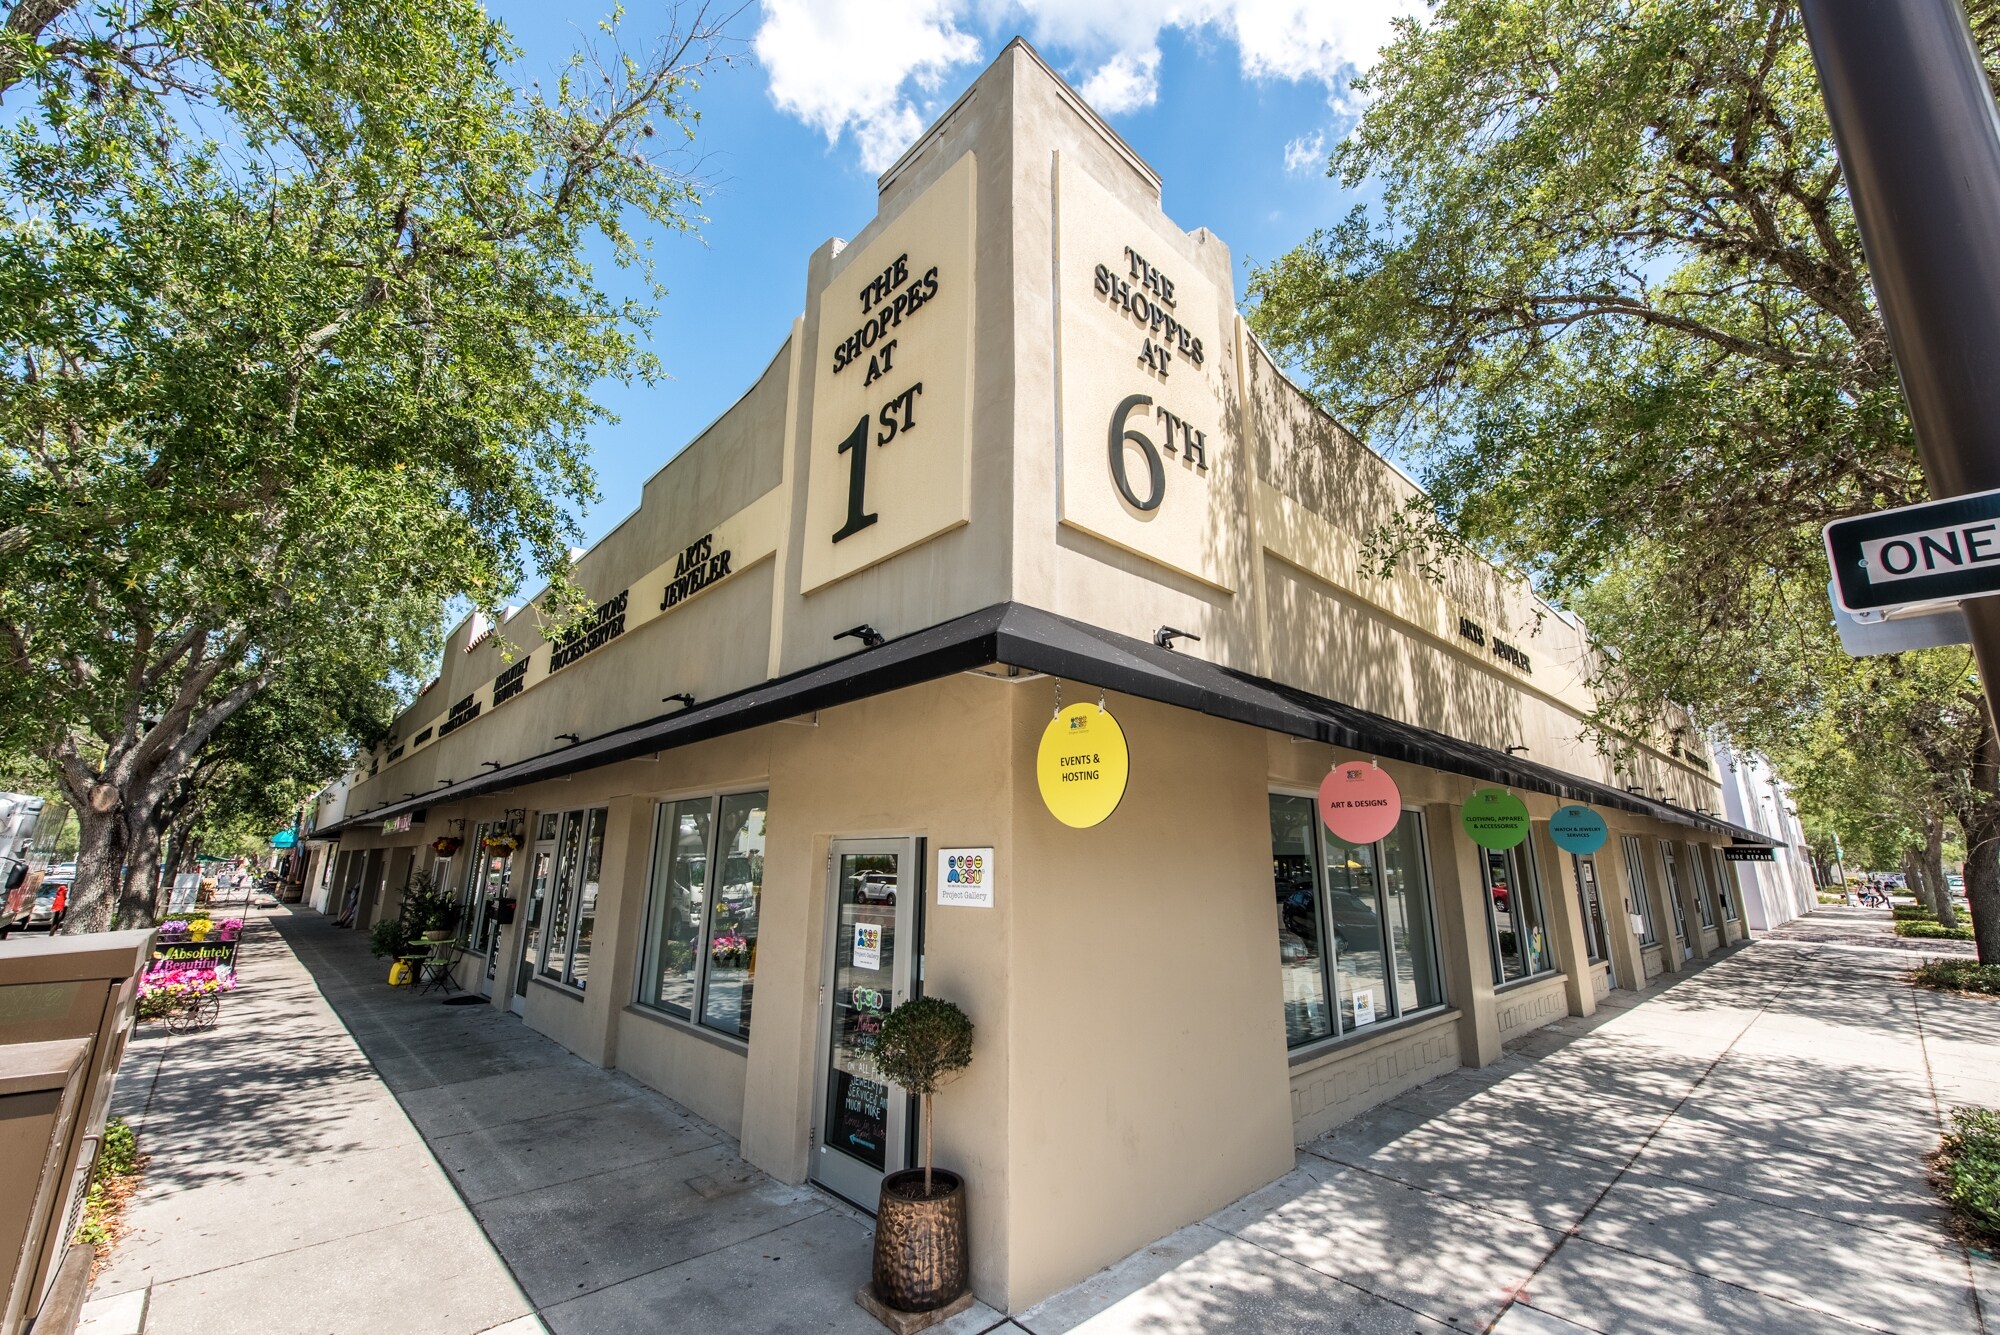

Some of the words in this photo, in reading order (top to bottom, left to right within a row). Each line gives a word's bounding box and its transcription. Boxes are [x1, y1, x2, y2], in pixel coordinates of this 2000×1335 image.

[860, 253, 908, 314] THE
[1125, 245, 1176, 309] THE
[833, 266, 938, 374] SHOPPES
[1094, 263, 1204, 365] SHOPPES
[863, 339, 897, 387] AT
[1138, 337, 1171, 377] AT
[832, 382, 923, 544] 1ST
[1108, 393, 1209, 511] 6TH
[673, 533, 713, 579] ARTS
[1881, 524, 2000, 575] ONE
[660, 550, 732, 611] JEWELER
[549, 636, 587, 674] PROCESS
[585, 613, 625, 654] SERVER
[1459, 616, 1485, 647] ARTS
[1493, 636, 1533, 674] JEWELER
[1060, 754, 1090, 766] EVENTS
[1093, 753, 1100, 764] &
[1062, 770, 1099, 782] HOSTING
[1355, 799, 1388, 807] DESIGNS
[942, 890, 963, 901] Project
[964, 891, 988, 901] Gallery
[165, 957, 219, 971] Beautiful
[170, 945, 232, 960] Absolutely
[859, 1062, 869, 1075] ALL
[847, 1084, 877, 1106] SERVICES
